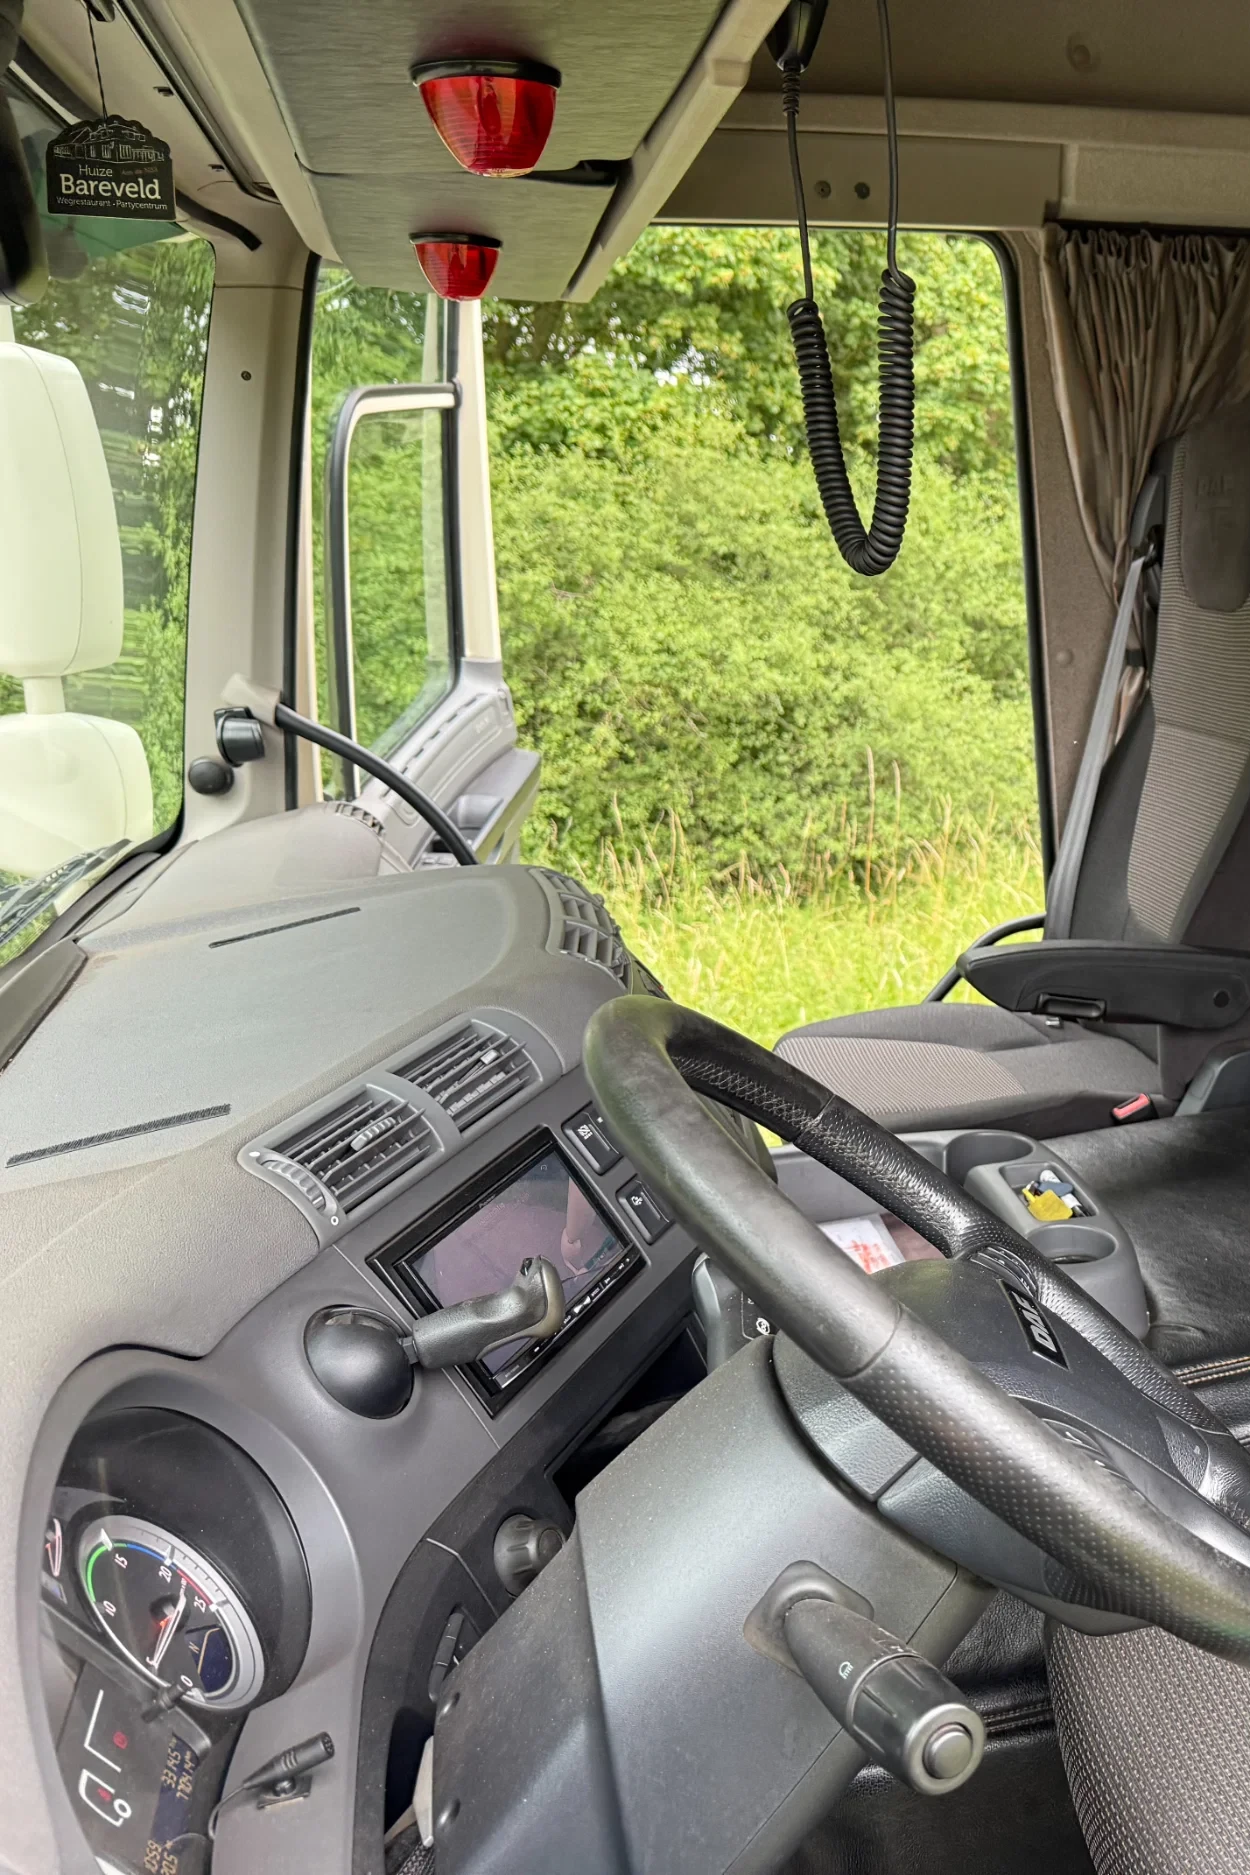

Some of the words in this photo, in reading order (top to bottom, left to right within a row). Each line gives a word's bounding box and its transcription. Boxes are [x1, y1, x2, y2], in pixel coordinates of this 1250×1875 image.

[78, 164, 113, 177] Huize
[59, 173, 161, 200] Bareveld
[115, 199, 168, 210] Partycentrum
[1011, 1291, 1057, 1353] DAF
[114, 1553, 128, 1569] 15
[158, 1565, 173, 1583] 20
[102, 1600, 117, 1617] 10
[193, 1595, 207, 1613] 25
[180, 1674, 193, 1687] 0
